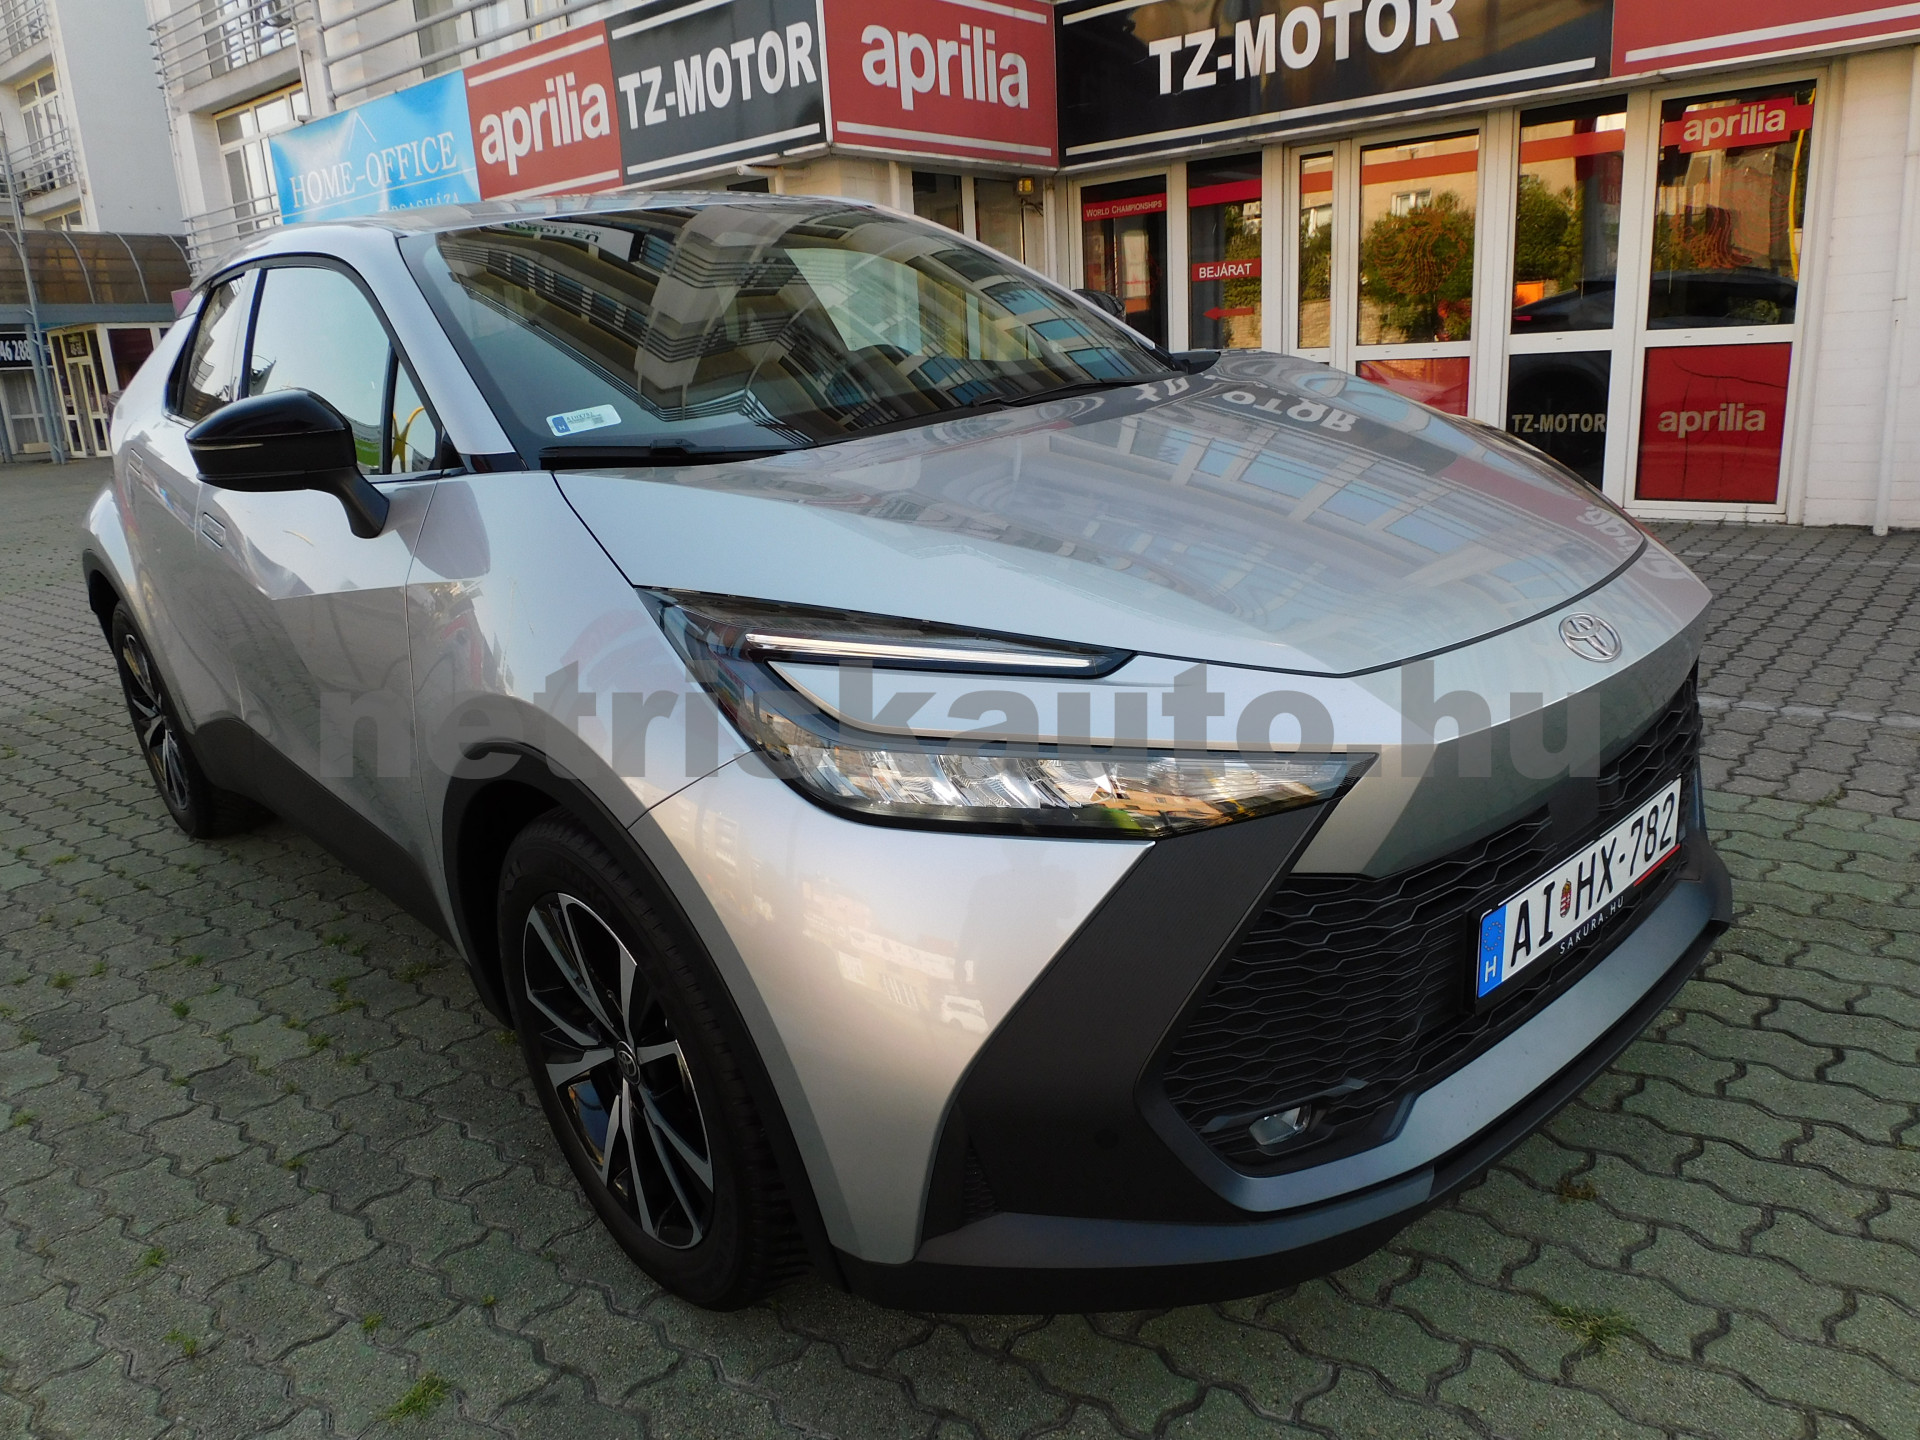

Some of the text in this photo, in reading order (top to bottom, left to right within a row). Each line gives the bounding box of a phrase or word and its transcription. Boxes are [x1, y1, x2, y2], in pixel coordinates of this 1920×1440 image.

[618, 21, 818, 130] TZ-MOTOR
[860, 22, 1030, 111] aprilia
[1147, 0, 1461, 96] TZ-MOTOR
[479, 71, 611, 177] aprilia
[1683, 104, 1787, 147] aprilia
[289, 131, 458, 209] HOME-OFFICE
[1085, 199, 1163, 218] WORLD CHAMPIONSHIPS
[1198, 262, 1253, 280] BEJÁRAT
[1511, 412, 1607, 434] TZ-MOTOR
[1657, 403, 1767, 440] aprilia
[1510, 791, 1676, 967] AI HX-782
[1558, 895, 1624, 955] SAKURA.HU
[1484, 955, 1498, 983] H
